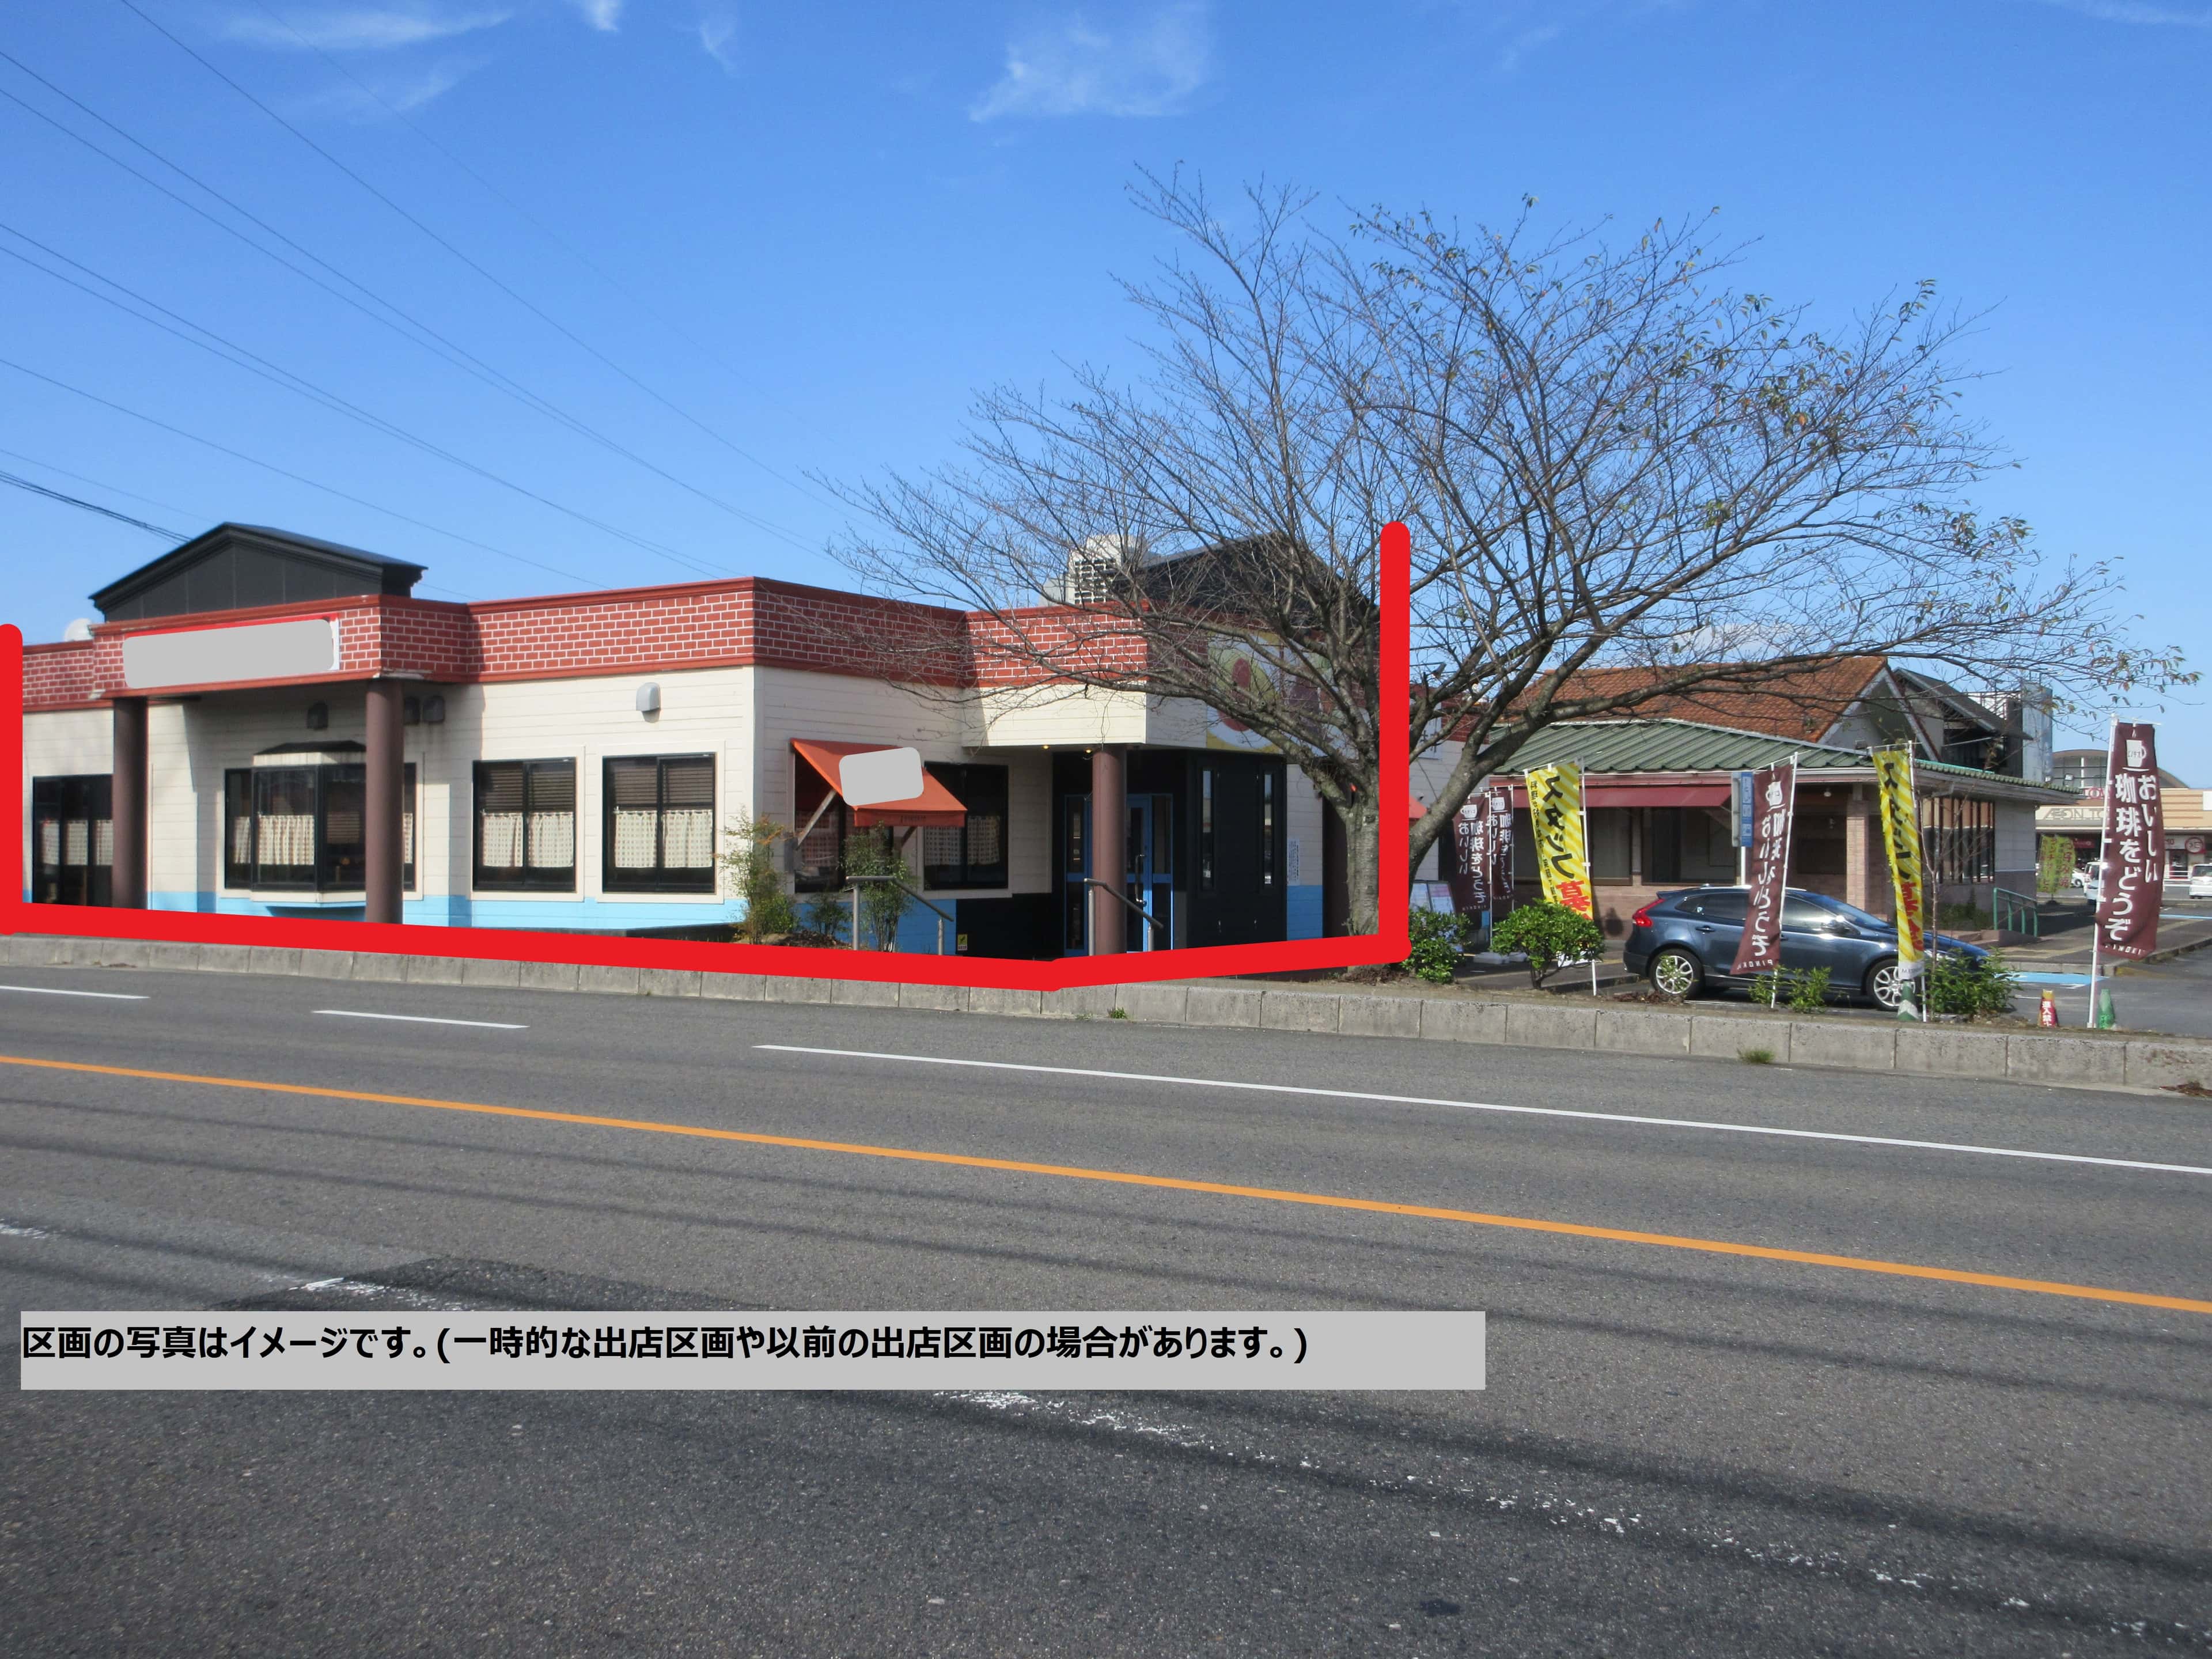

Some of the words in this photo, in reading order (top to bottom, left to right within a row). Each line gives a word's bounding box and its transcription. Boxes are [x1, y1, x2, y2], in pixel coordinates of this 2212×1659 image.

[2105, 773, 2142, 941] 珈琲をどうぞ
[2138, 775, 2158, 883] おいしい
